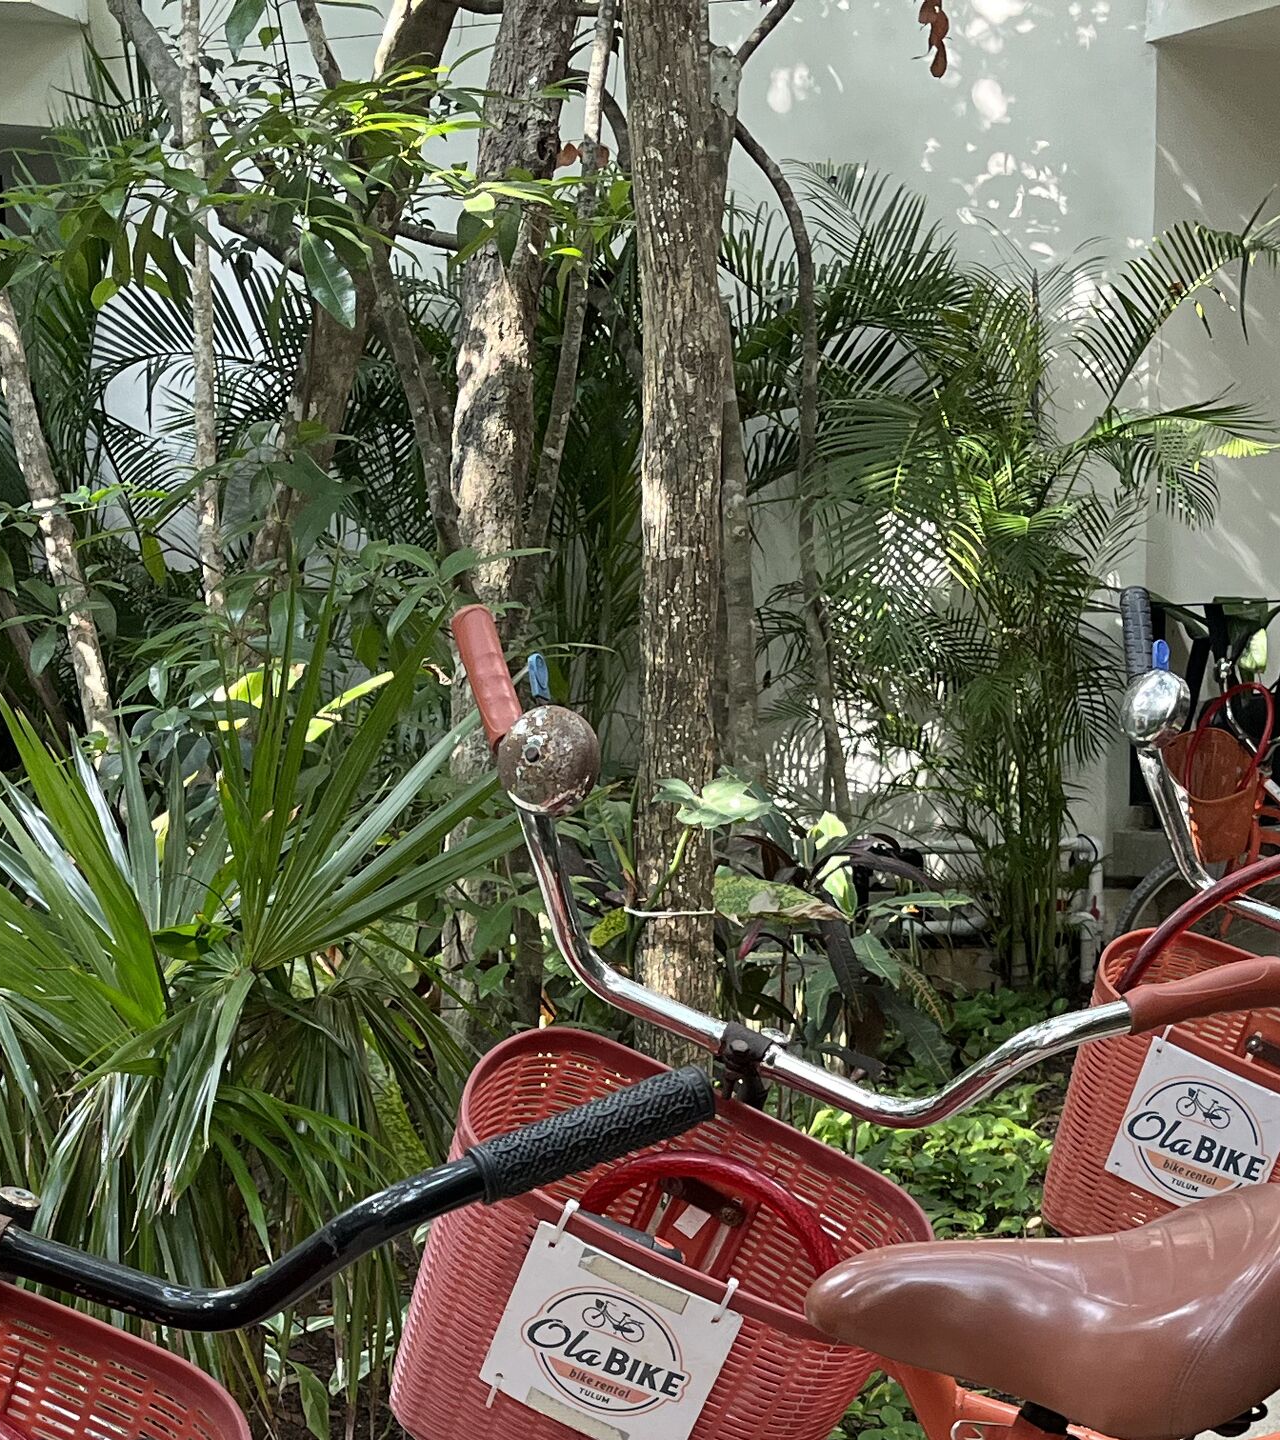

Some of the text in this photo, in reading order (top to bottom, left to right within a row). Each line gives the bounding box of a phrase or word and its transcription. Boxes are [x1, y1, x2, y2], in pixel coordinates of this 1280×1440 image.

[1162, 1159, 1217, 1186] bike rental
[1171, 1177, 1199, 1192] TULUM
[568, 1368, 631, 1399] bike rental
[579, 1387, 610, 1405] TULUM
